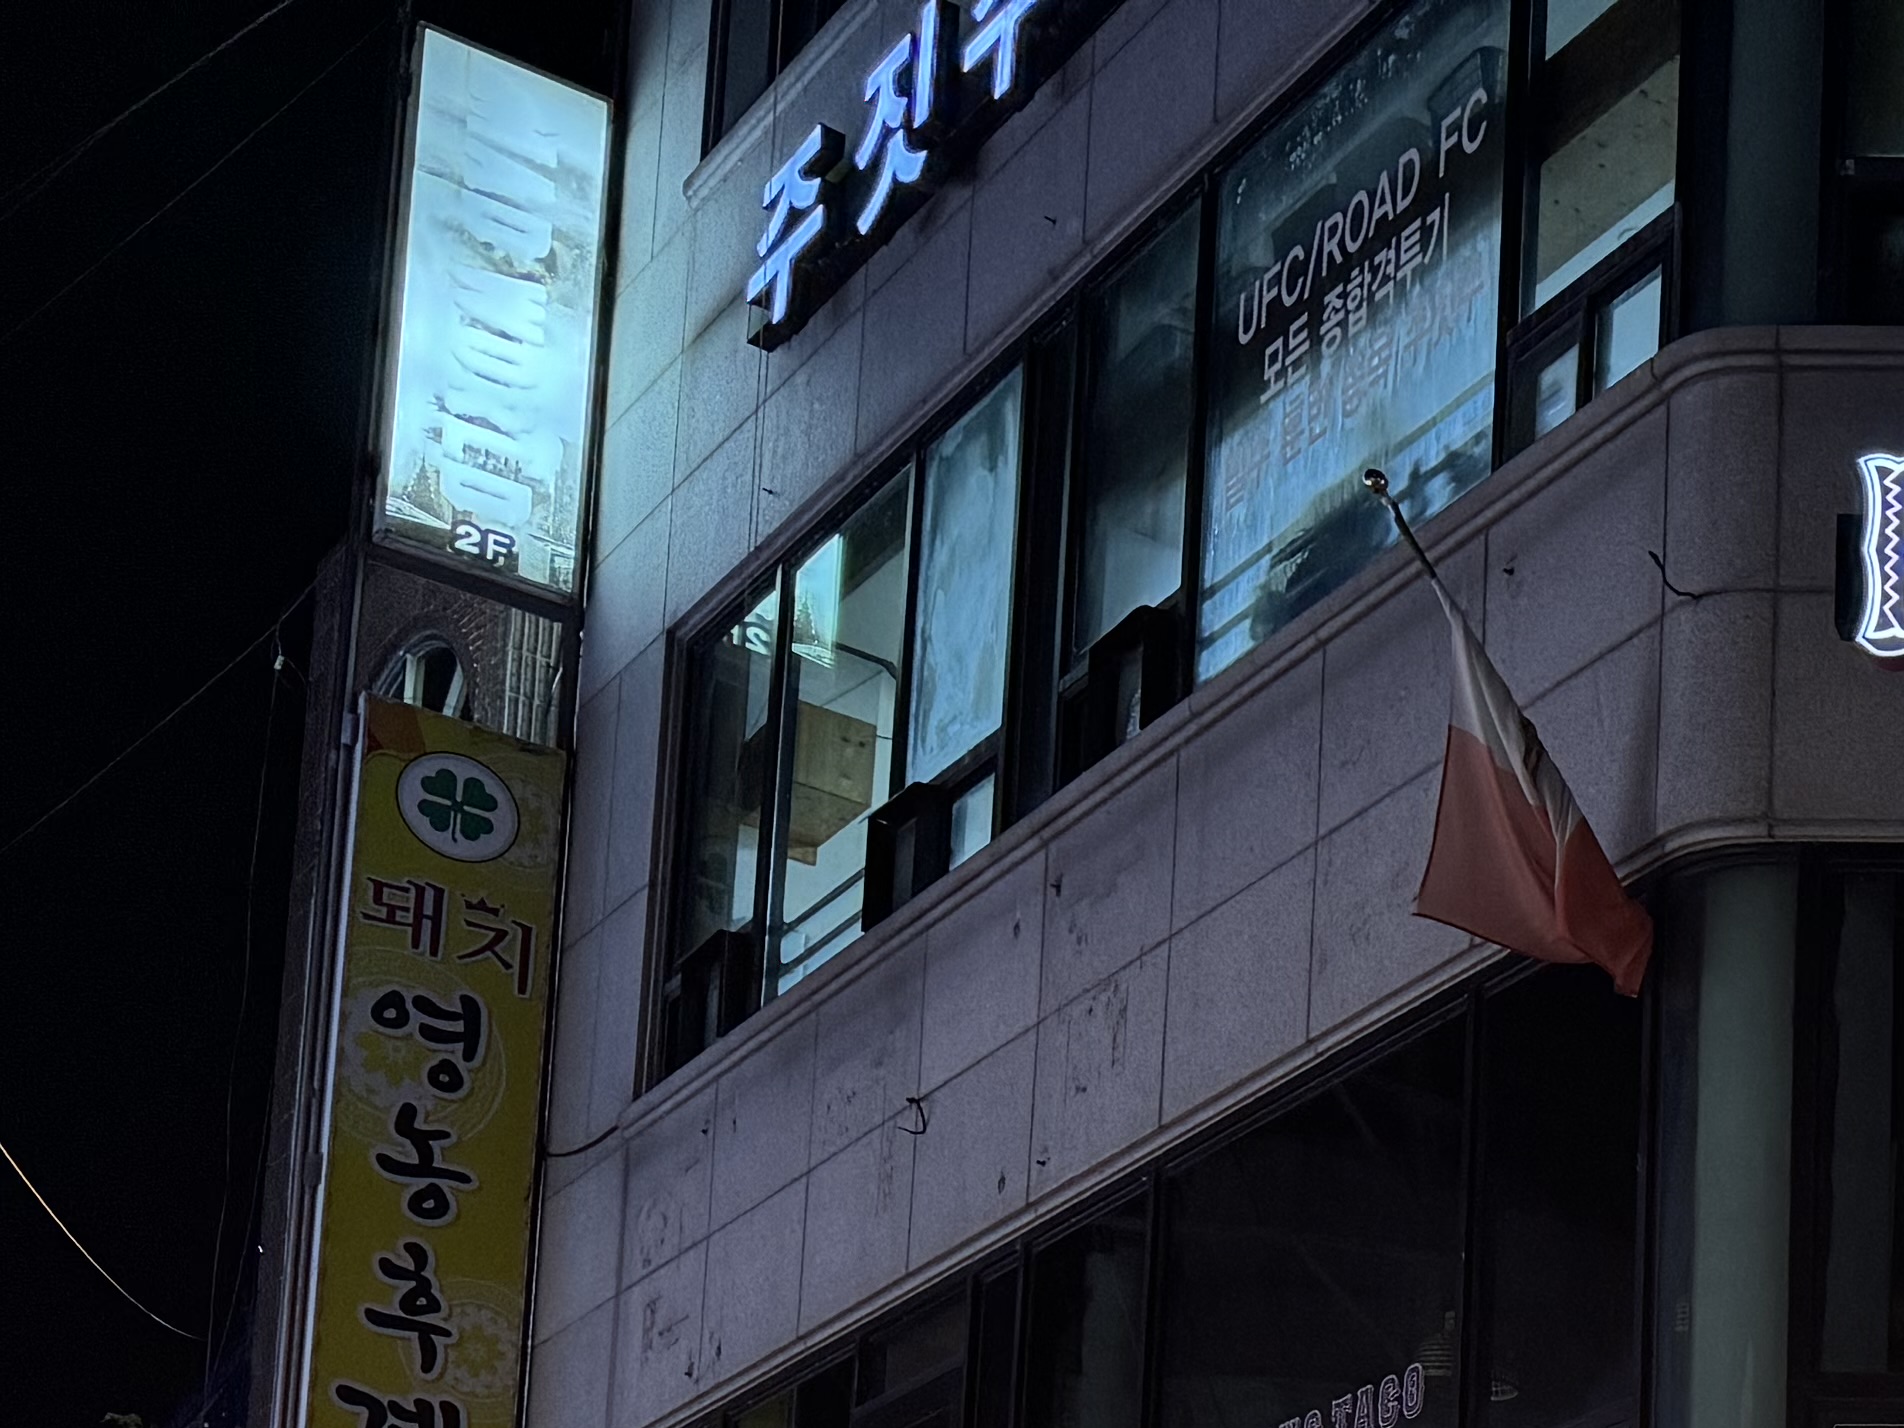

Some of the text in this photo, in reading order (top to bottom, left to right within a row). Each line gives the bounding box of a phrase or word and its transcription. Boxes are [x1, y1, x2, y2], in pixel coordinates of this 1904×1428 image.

[1237, 86, 1489, 347] UFC/ROAD FC
[1259, 192, 1451, 405] 모든 종합격투기
[453, 523, 517, 565] 2F
